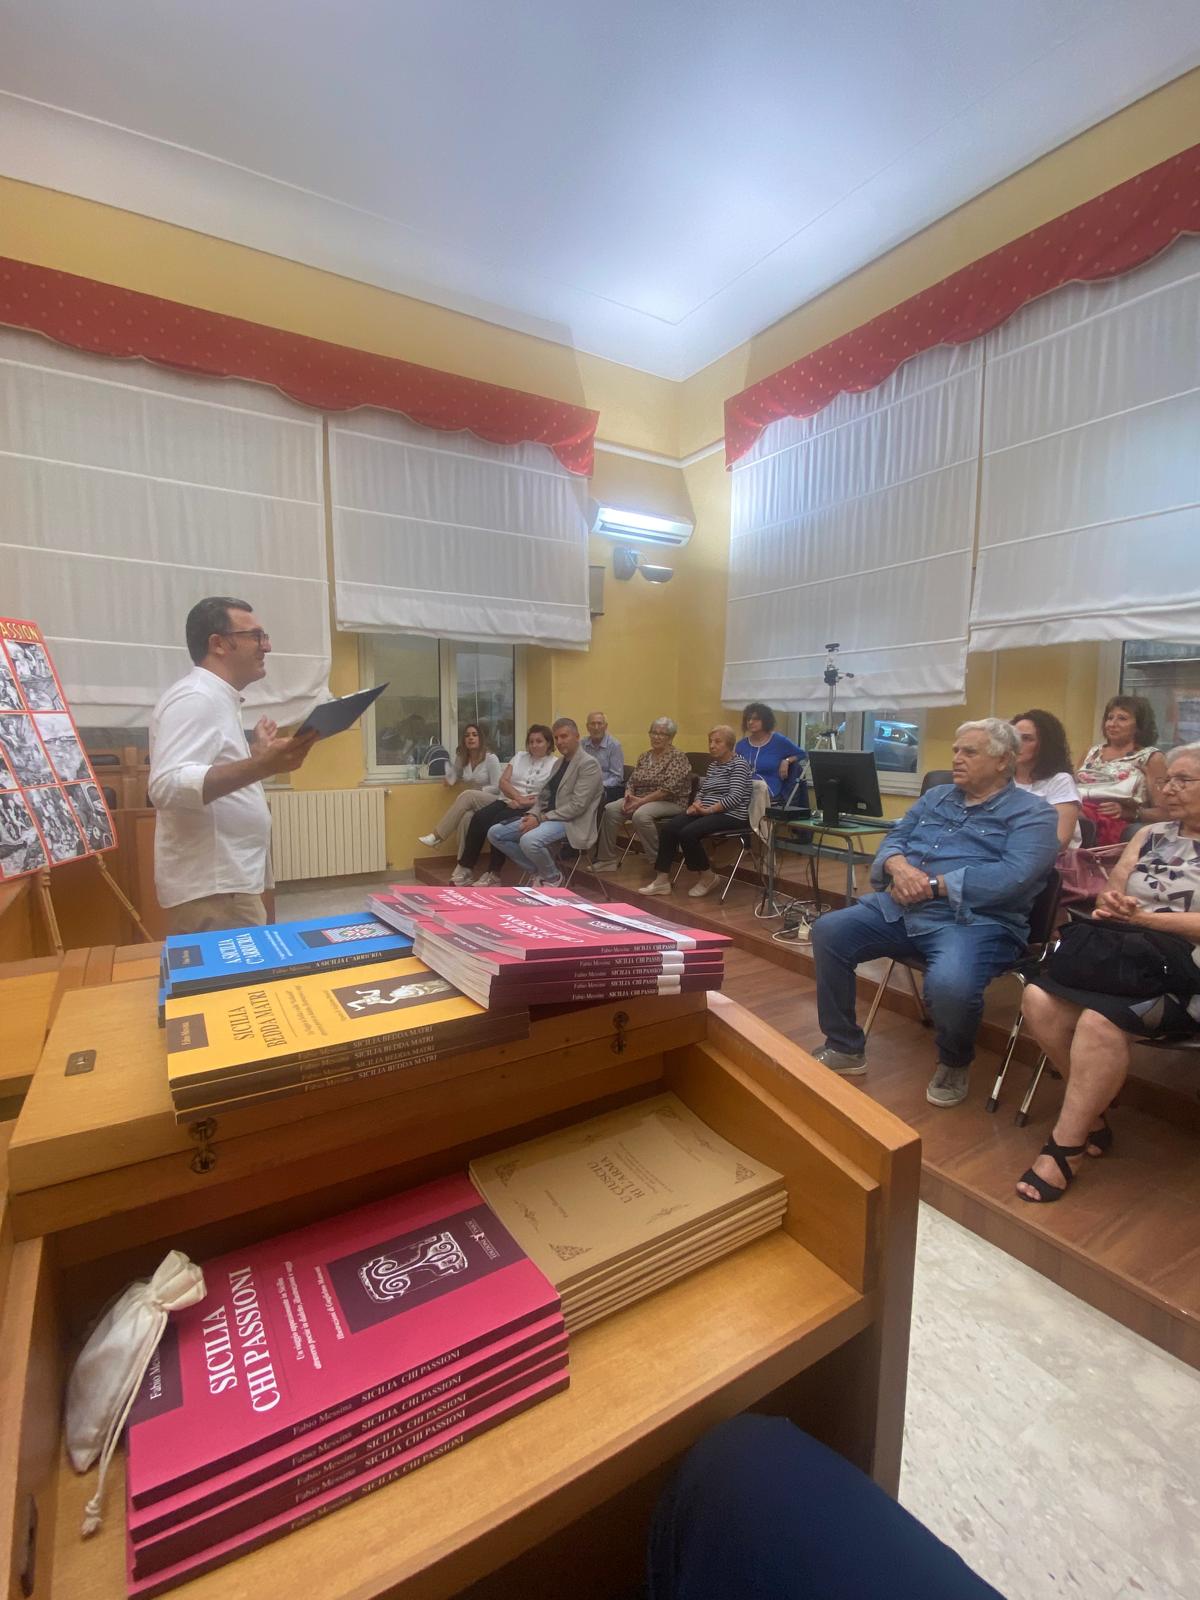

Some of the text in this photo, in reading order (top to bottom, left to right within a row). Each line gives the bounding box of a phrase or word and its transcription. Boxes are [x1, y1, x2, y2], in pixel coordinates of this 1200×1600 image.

[227, 1006, 255, 1040] SICILIA
[248, 990, 287, 1048] BEDDA MATRI
[202, 1305, 238, 1394] SICILIA
[229, 1266, 281, 1412] CHI PASSIONI
[150, 1375, 162, 1400] Fabio
[361, 1381, 398, 1402] SICILIA
[401, 1370, 419, 1384] CHI
[420, 1349, 461, 1375] PASSIONI
[361, 1408, 398, 1431] SICILIA
[401, 1396, 419, 1411] CHI
[420, 1375, 462, 1401] PASSIONI
[364, 1444, 402, 1467] SICILIA
[405, 1431, 423, 1447] CHI
[425, 1409, 467, 1436] PASSIONI
[366, 1427, 403, 1450] SICILIA
[406, 1414, 424, 1430] CHI
[425, 1393, 467, 1419] PASSIONI
[361, 1471, 399, 1494] SICILIA
[402, 1458, 420, 1473] CHI
[422, 1435, 464, 1461] PASSIONI
